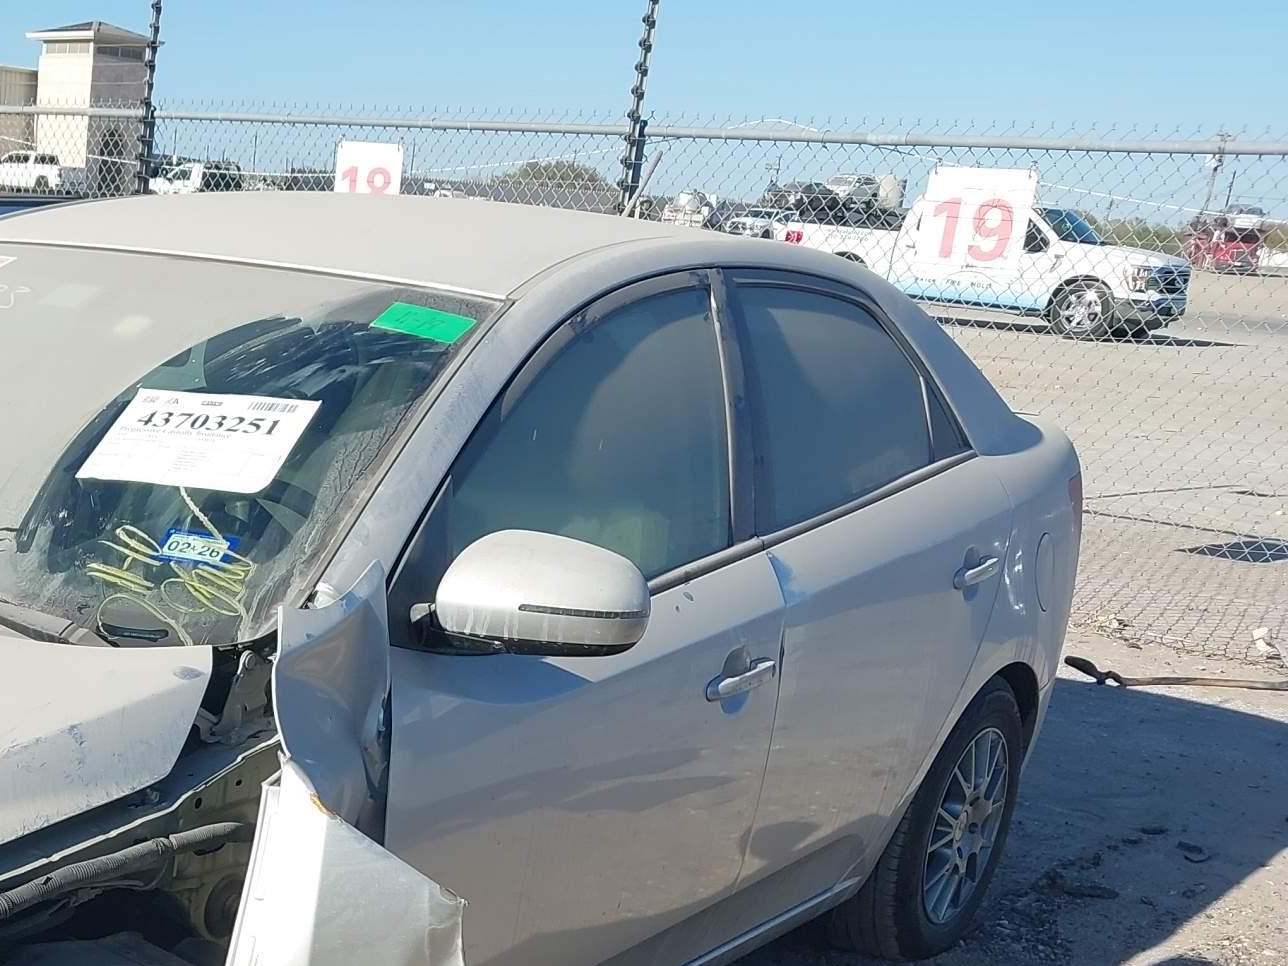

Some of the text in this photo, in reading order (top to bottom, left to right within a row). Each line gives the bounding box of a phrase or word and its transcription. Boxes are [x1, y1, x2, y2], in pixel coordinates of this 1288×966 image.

[933, 196, 1014, 262] 19
[137, 410, 281, 436] 43703251
[167, 540, 192, 554] 02
[198, 545, 220, 558] 26
